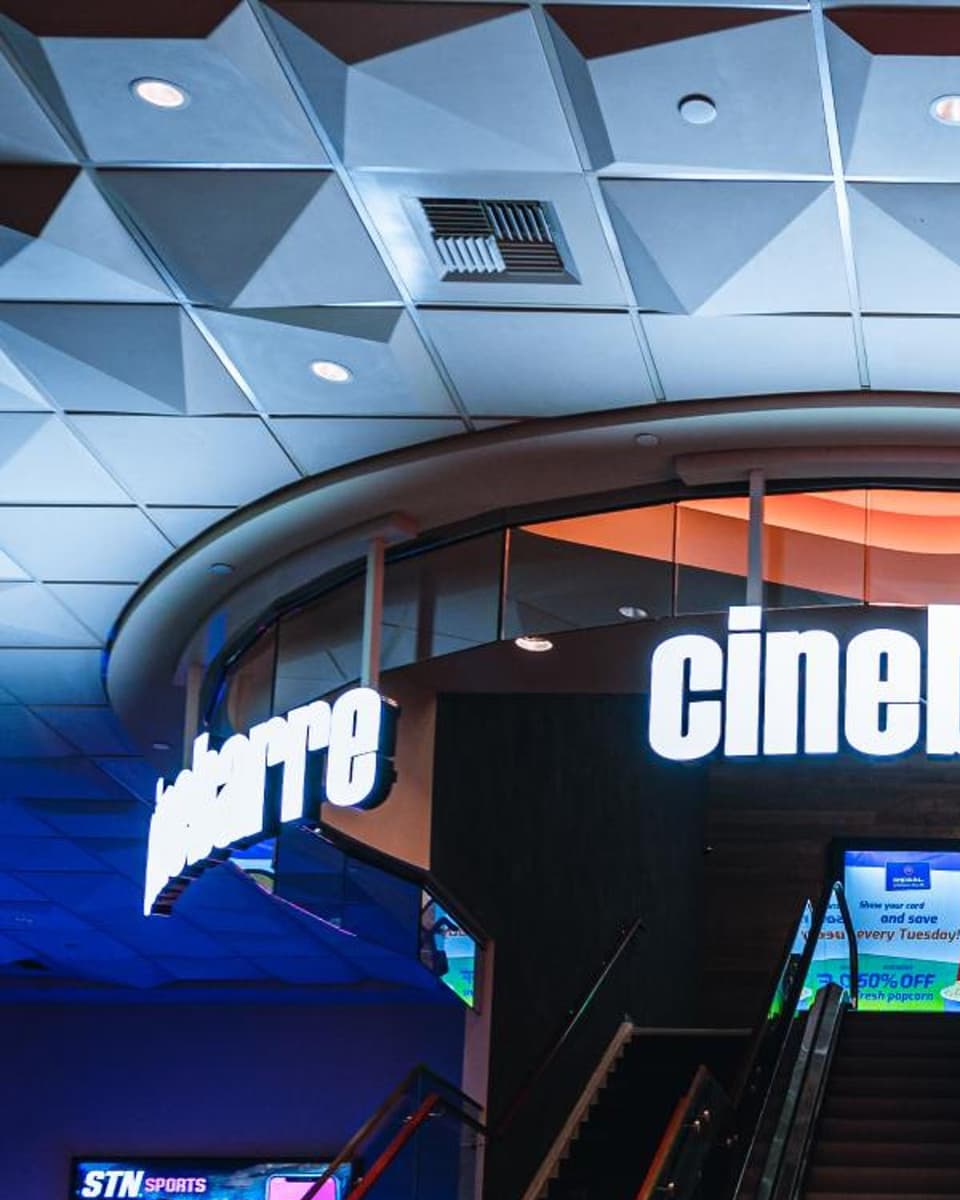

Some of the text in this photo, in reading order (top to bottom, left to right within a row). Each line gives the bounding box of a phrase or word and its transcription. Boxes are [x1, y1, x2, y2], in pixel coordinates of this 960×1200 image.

[885, 902, 903, 912] your
[905, 901, 925, 910] card
[880, 912, 938, 924] and save
[857, 930, 895, 941] every
[900, 928, 960, 943] Tuesday!
[901, 973, 936, 989] OFF
[859, 991, 934, 1003] resh popcorn
[81, 1170, 207, 1198] STN SPORTS
